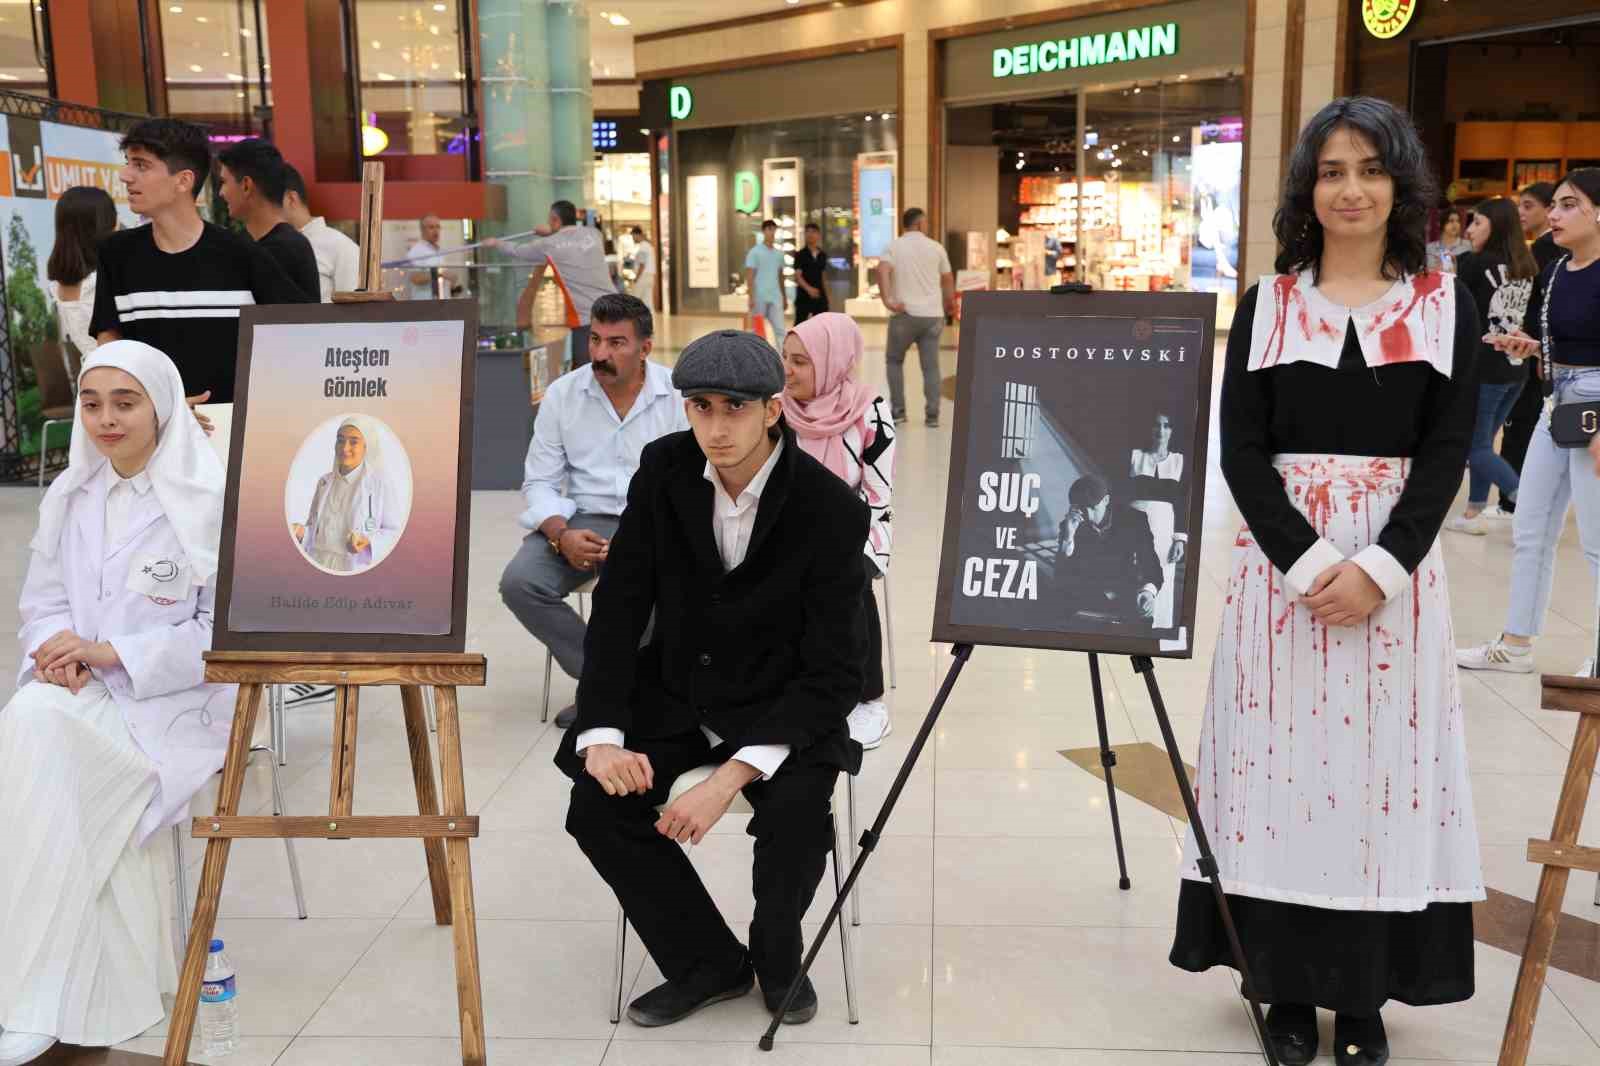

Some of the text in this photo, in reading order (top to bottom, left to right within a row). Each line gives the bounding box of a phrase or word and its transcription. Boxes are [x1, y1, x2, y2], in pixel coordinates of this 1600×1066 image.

[993, 23, 1176, 78] DEICHMANN
[670, 86, 692, 120] D
[734, 171, 761, 214] D
[325, 347, 390, 373] Ateşten
[995, 346, 1185, 362] DOSTOYEVSKİ
[323, 376, 388, 398] Gömlek
[978, 471, 1041, 518] SUÇ
[995, 526, 1017, 550] VE
[962, 556, 1038, 600] CEZA
